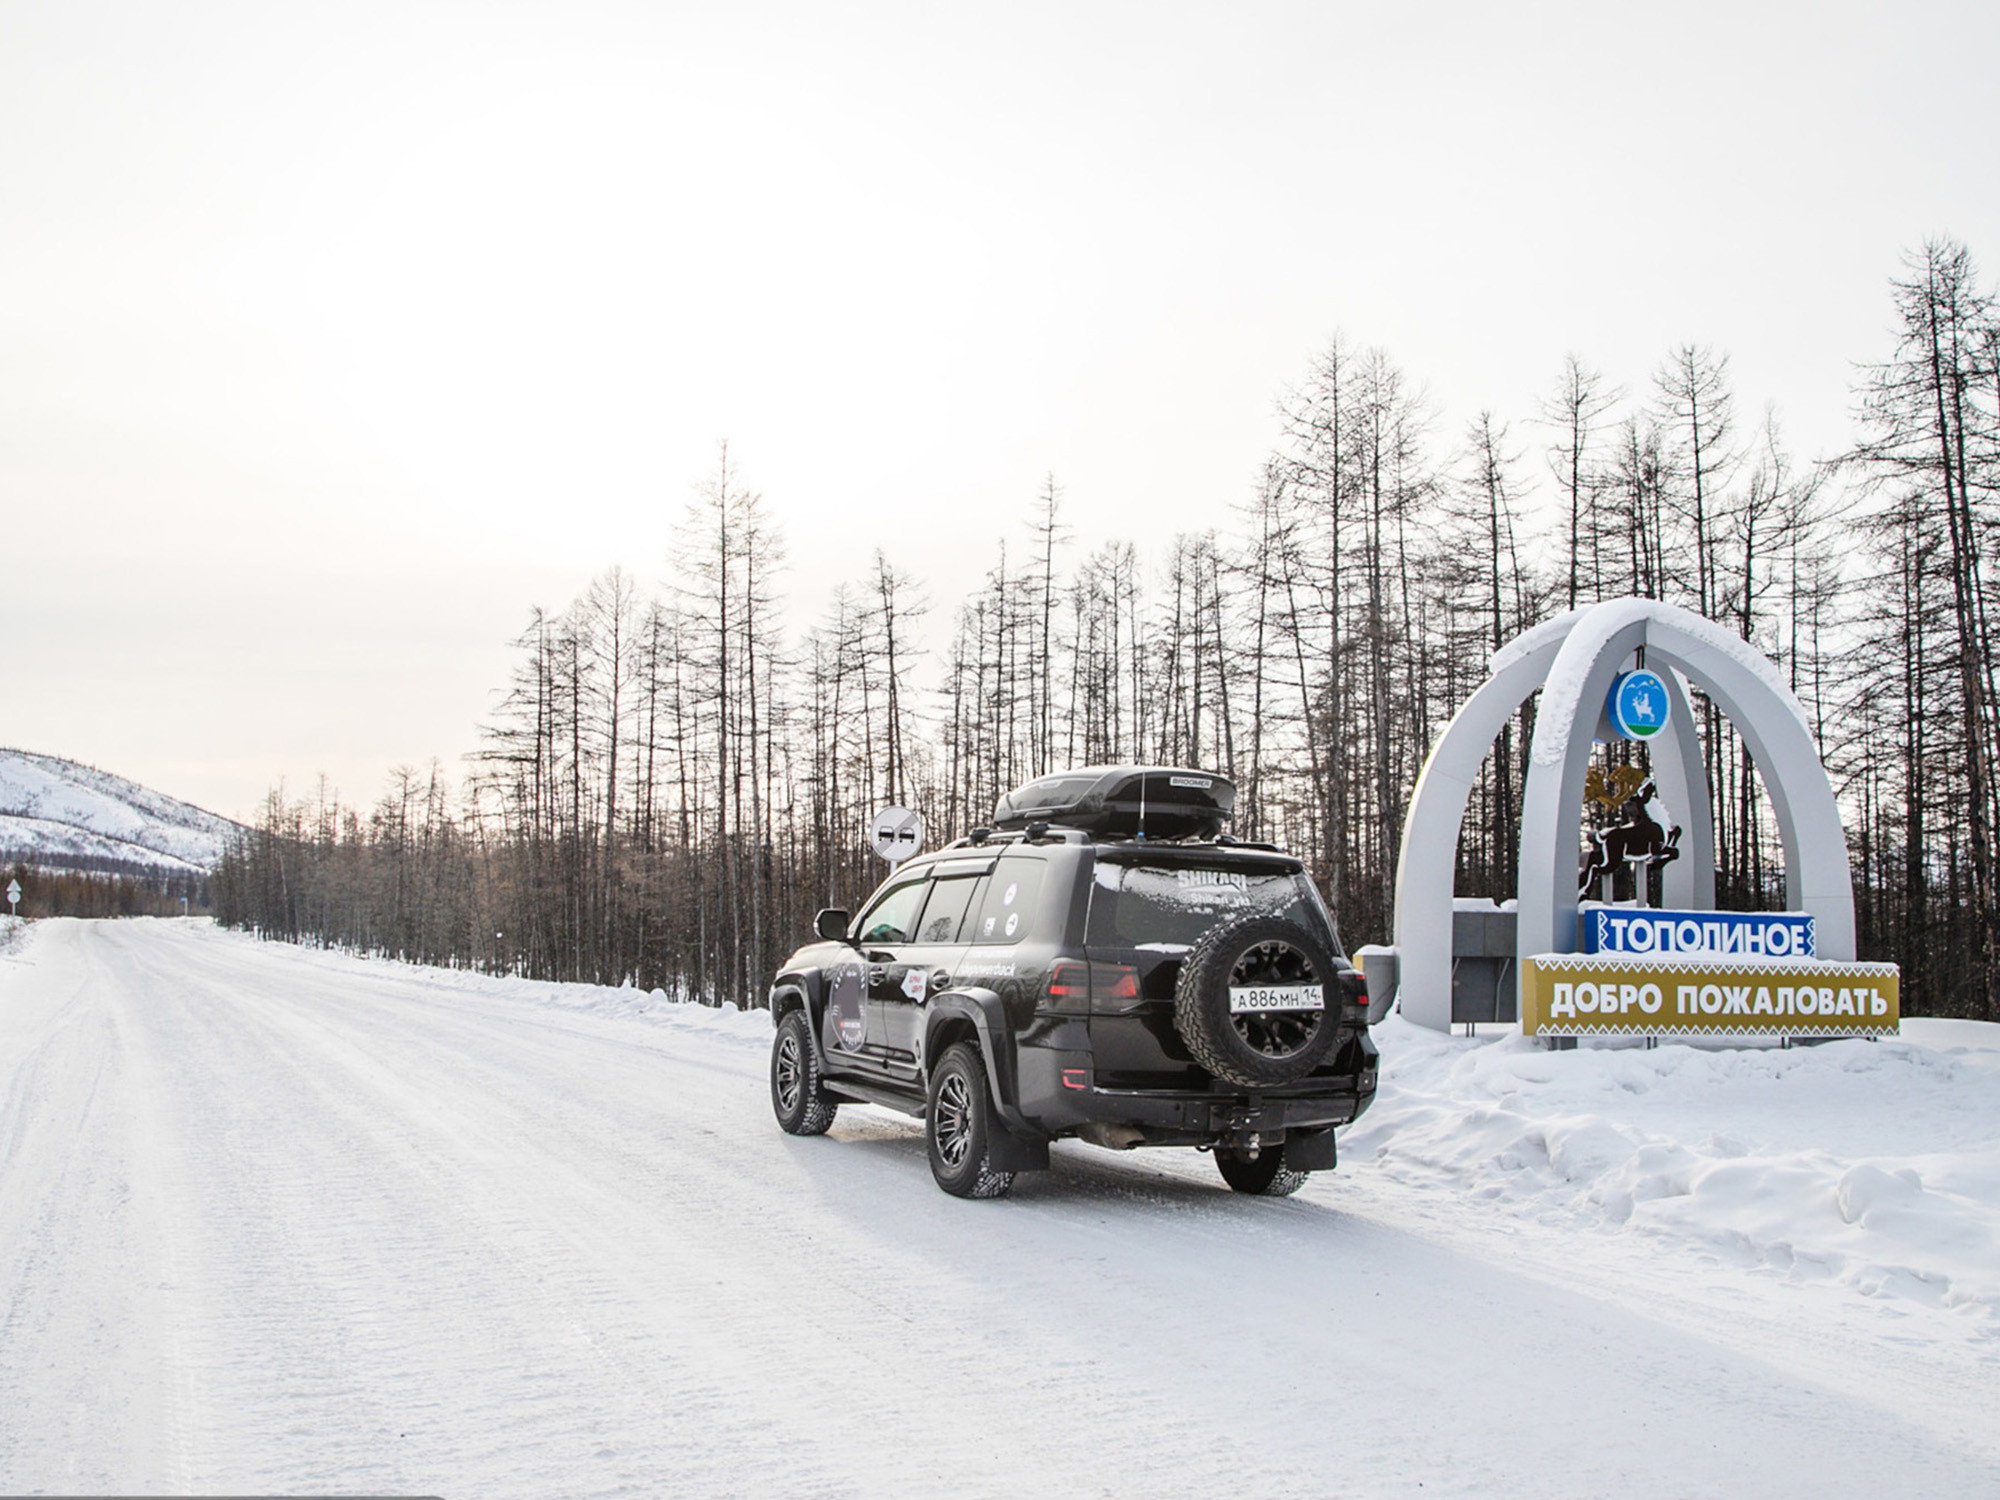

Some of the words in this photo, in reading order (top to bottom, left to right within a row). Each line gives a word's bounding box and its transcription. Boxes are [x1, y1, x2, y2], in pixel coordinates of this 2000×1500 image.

[1173, 778, 1210, 787] BROOMER
[1177, 869, 1247, 892] SHIKARI
[1610, 918, 1806, 956] ТОПОЛИНОЕ
[1550, 982, 1663, 1018] ДОБРО
[1677, 983, 1889, 1016] ПОЖАЛОВАТЬ
